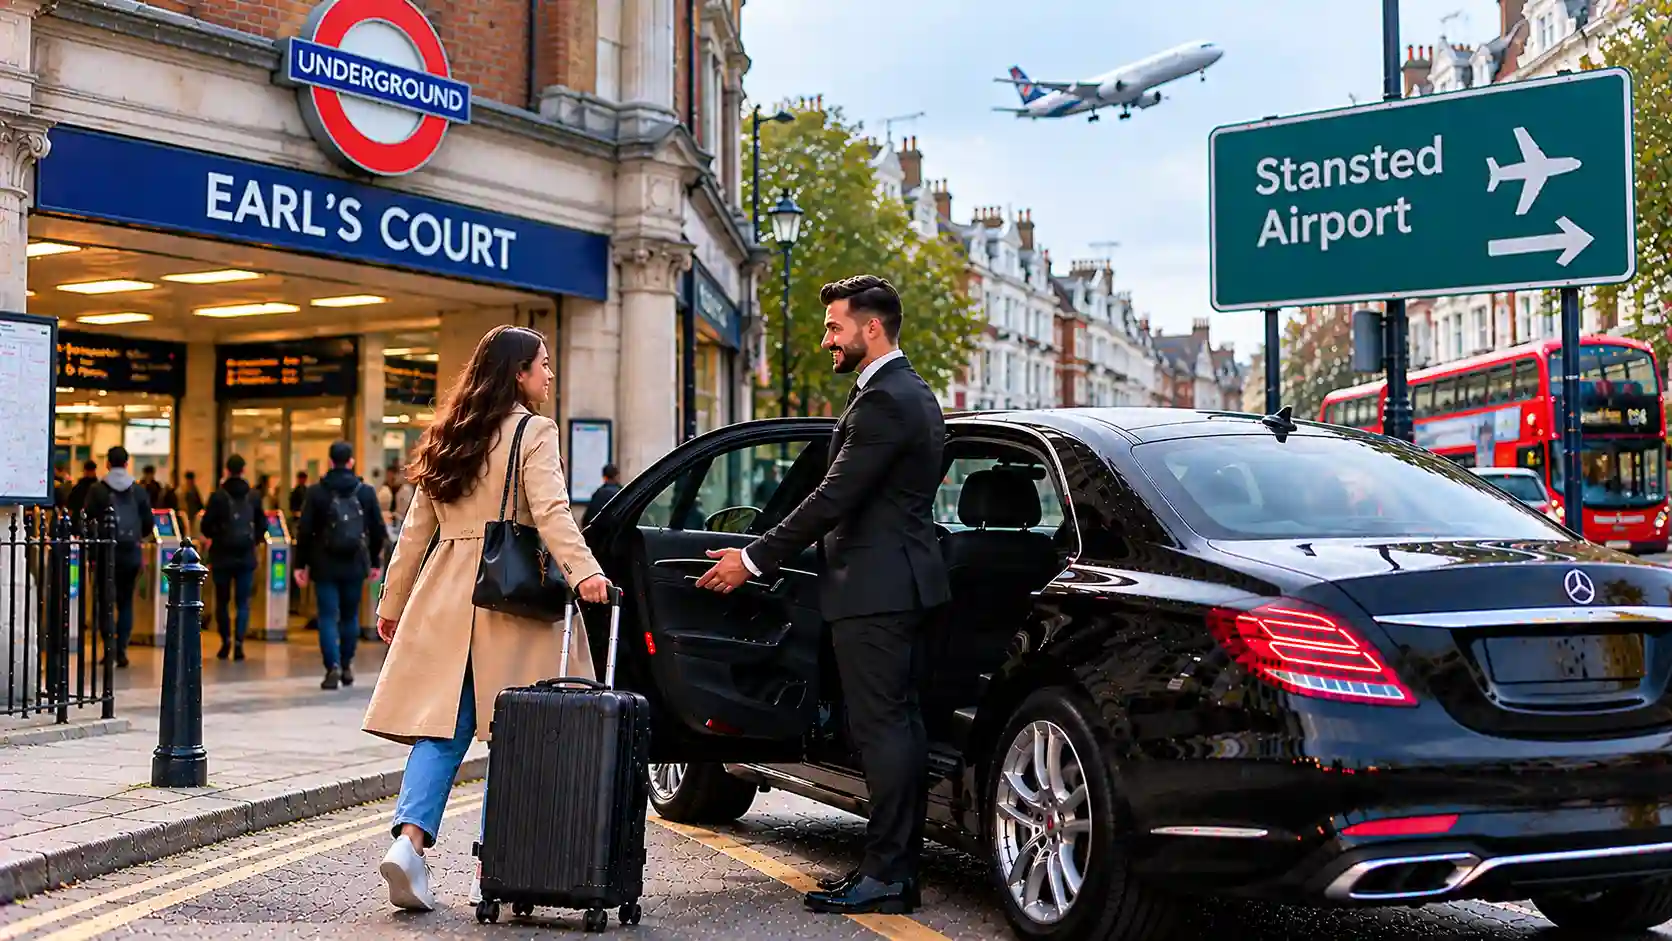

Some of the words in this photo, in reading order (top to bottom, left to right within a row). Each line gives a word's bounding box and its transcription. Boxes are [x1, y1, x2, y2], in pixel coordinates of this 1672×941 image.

[298, 50, 463, 111] UNDERGROUND
[1256, 134, 1443, 195] Stansted
[206, 171, 362, 242] EARL'S
[380, 207, 516, 270] COURT
[1257, 196, 1412, 251] Airport
